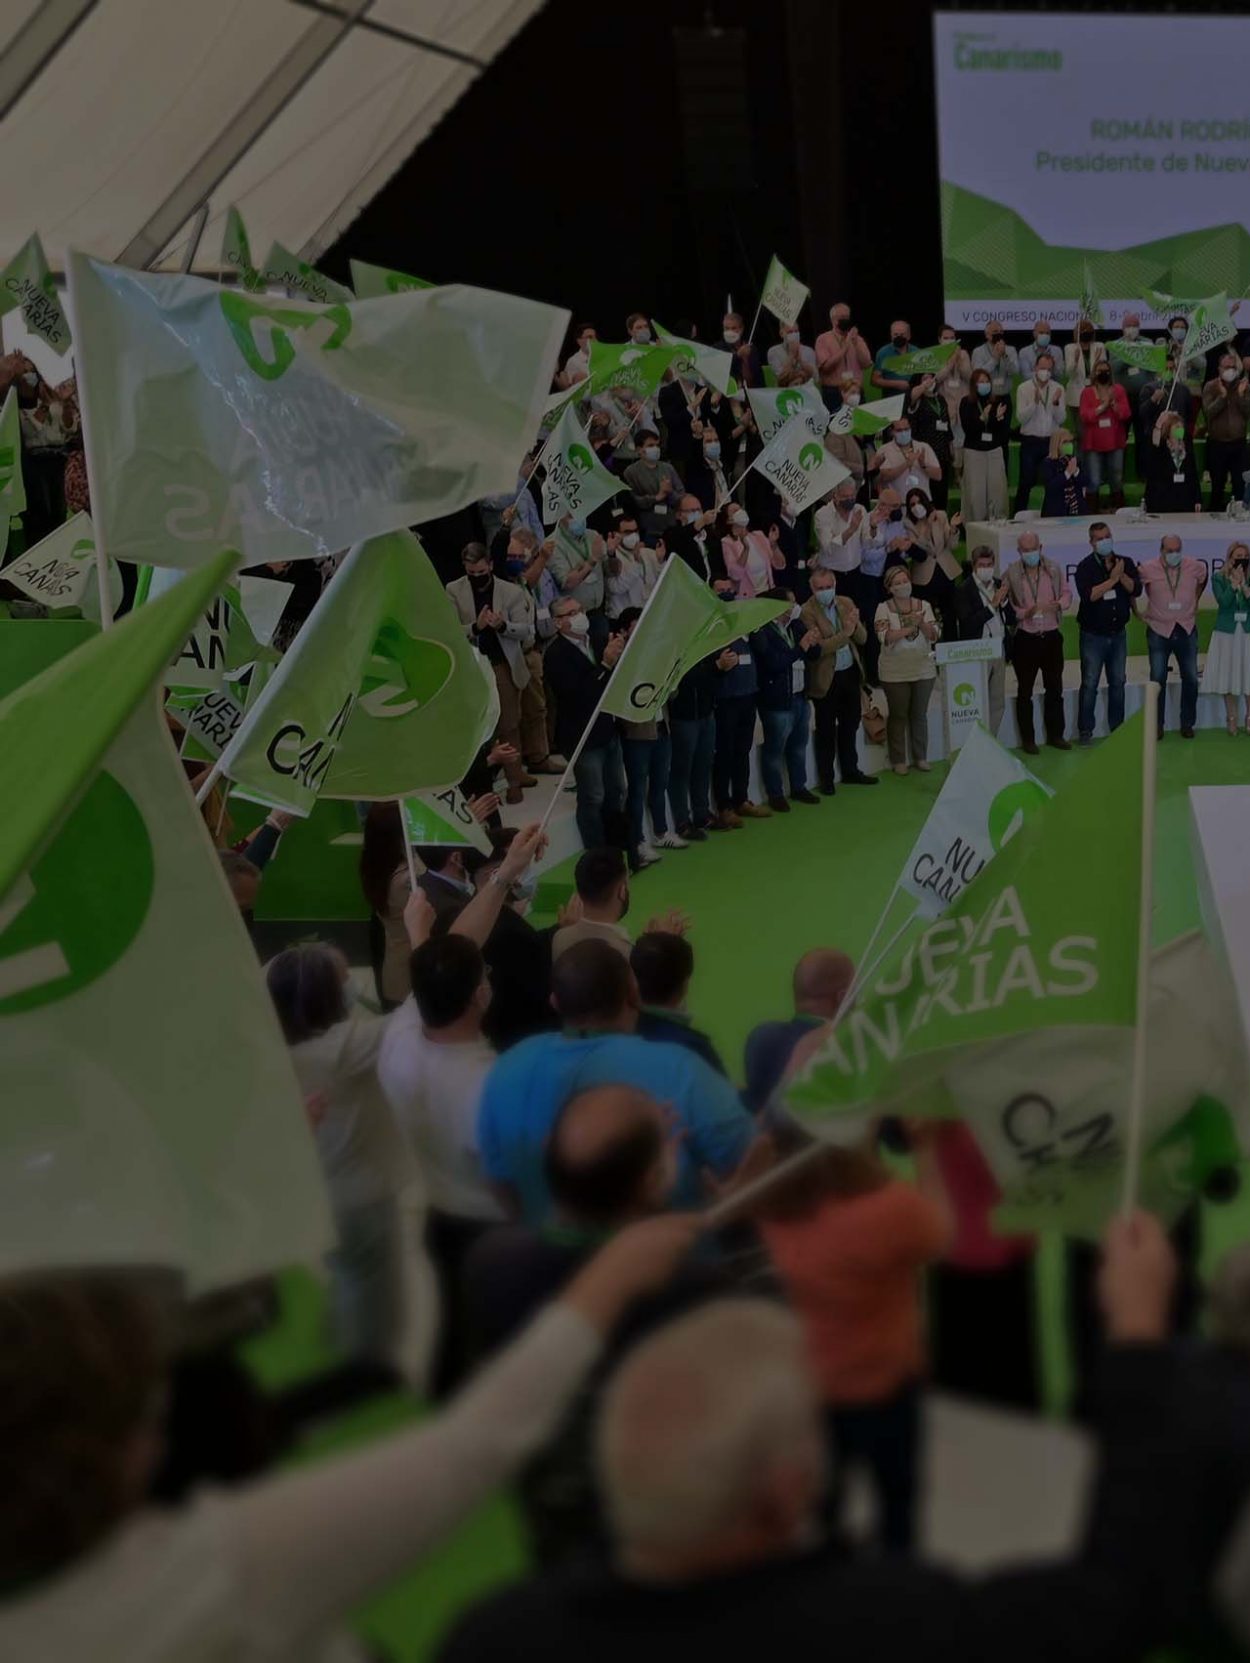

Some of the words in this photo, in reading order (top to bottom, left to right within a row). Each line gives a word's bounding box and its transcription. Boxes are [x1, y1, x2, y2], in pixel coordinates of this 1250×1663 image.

[1091, 115, 1174, 141] ROMÁN
[1036, 151, 1156, 173] Presidente
[1161, 152, 1188, 173] de
[5, 278, 62, 343] CAARIAS
[972, 311, 1037, 322] CONGRESO
[765, 460, 807, 504] CANARIAS
[782, 459, 810, 492] NUEVA
[951, 708, 980, 718] NUEVA
